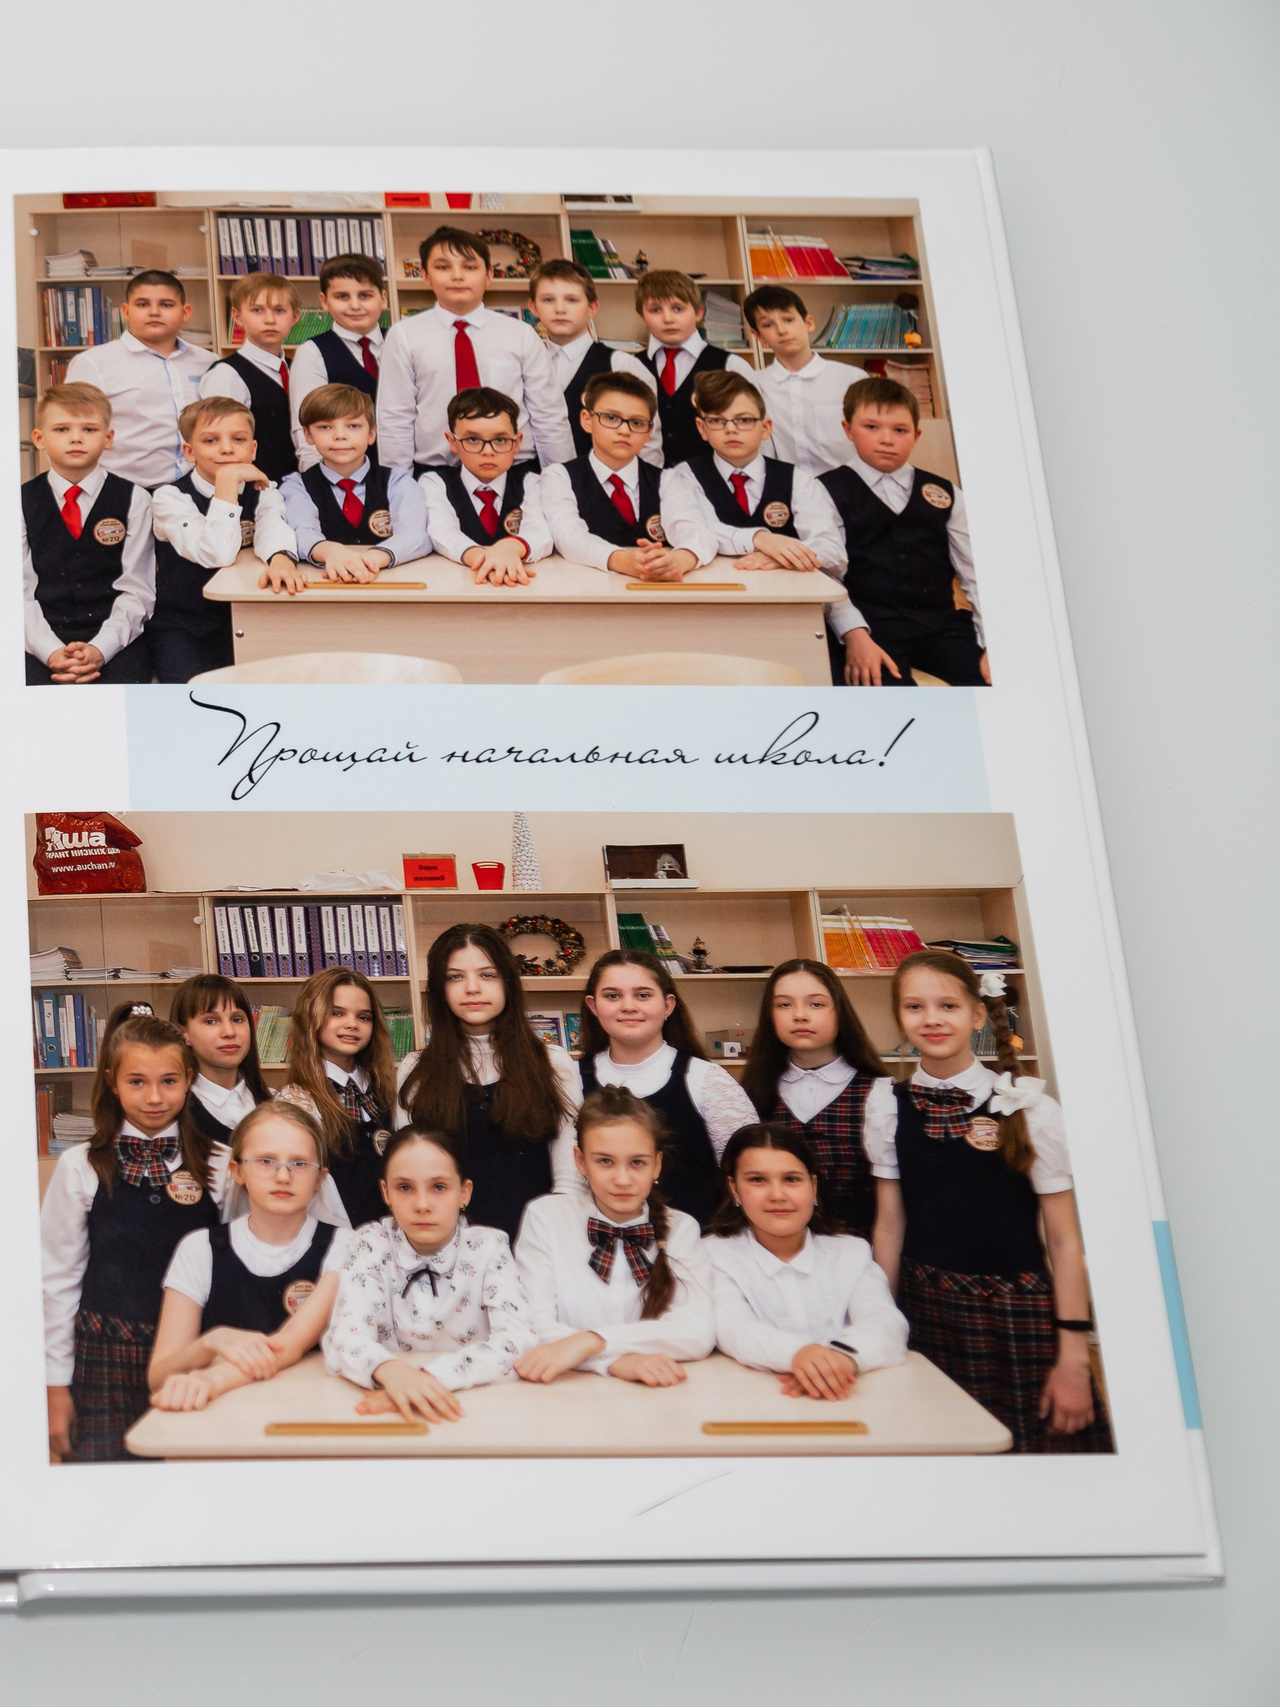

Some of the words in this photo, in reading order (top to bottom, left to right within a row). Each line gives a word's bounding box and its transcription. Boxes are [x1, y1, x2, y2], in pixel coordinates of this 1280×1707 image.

[189, 691, 427, 801] Прощай
[440, 744, 699, 765] начальная
[714, 711, 915, 768] школа!
[70, 848, 107, 857] НИЗКИХ
